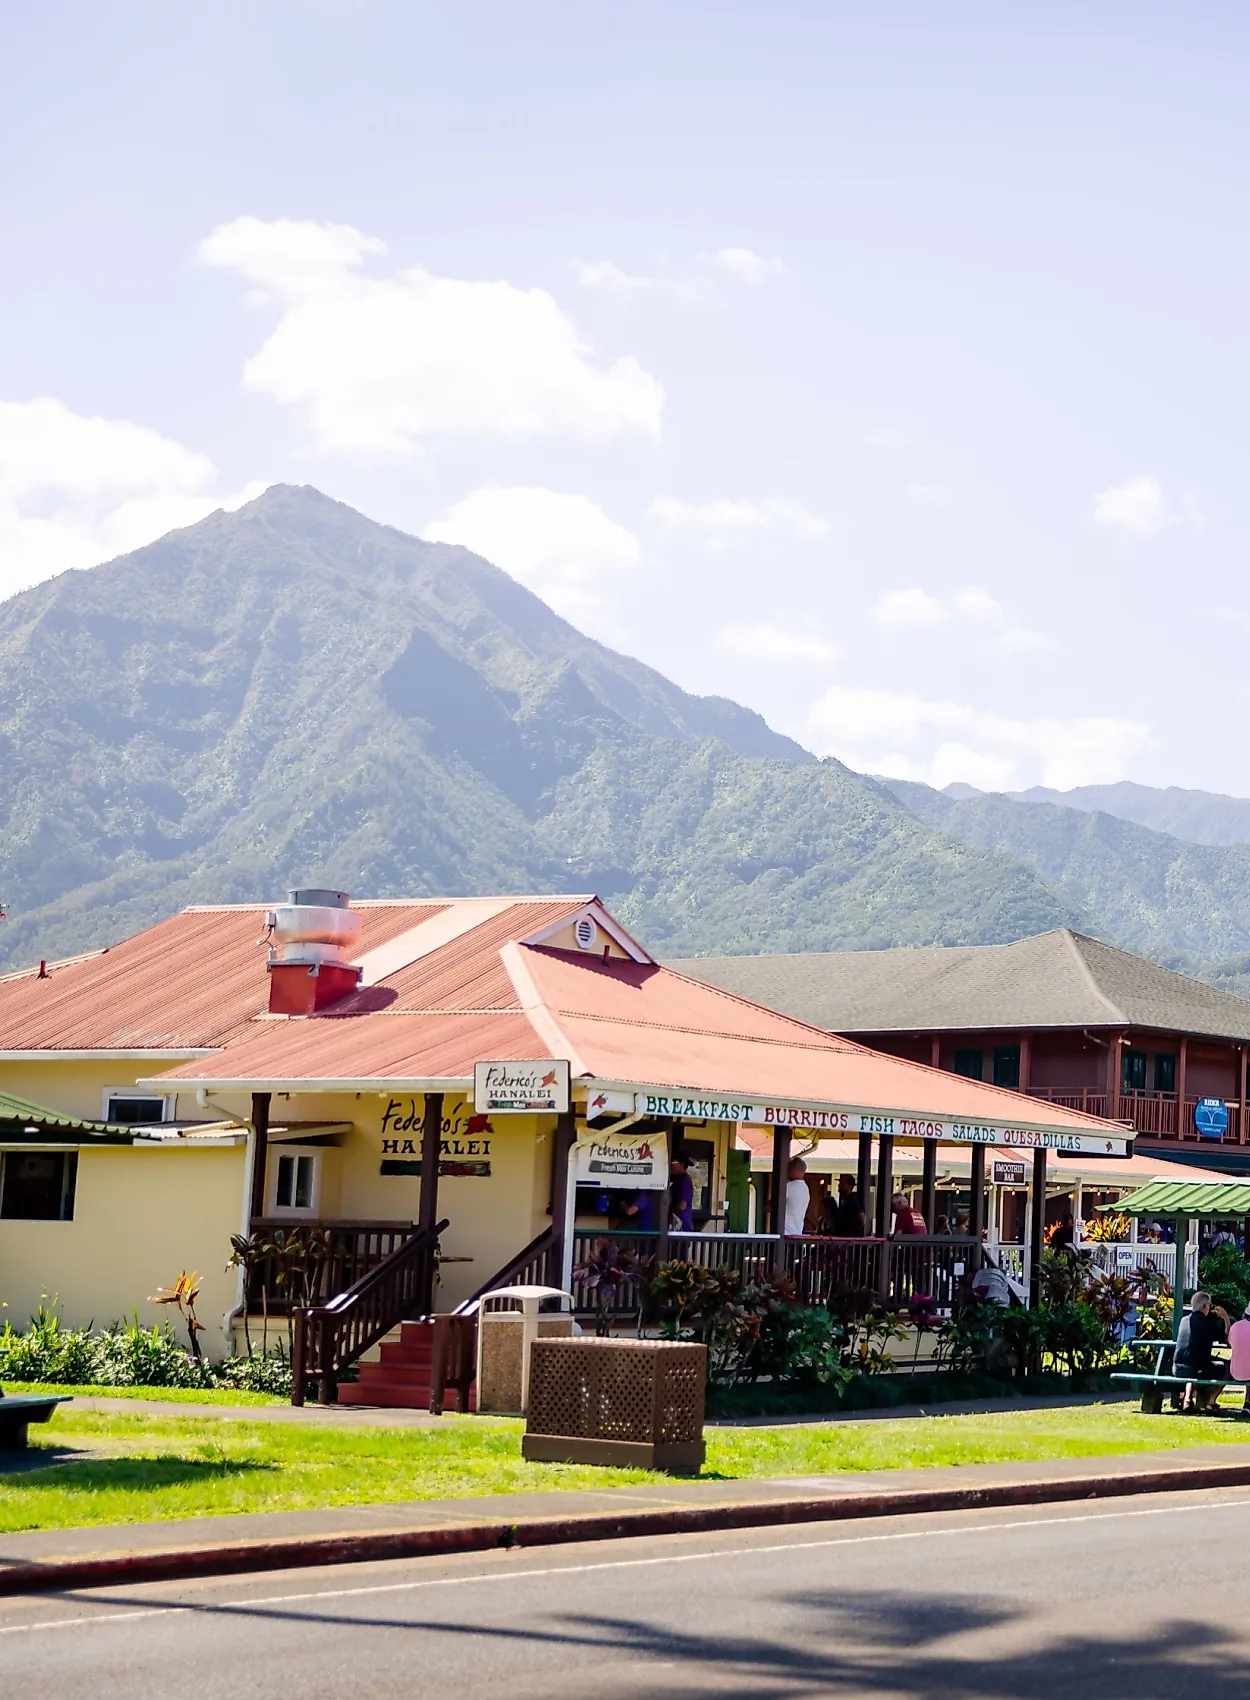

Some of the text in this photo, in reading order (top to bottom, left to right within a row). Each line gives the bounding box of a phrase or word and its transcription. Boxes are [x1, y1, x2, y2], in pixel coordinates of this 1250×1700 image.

[486, 1067, 537, 1088] Federico's
[489, 1090, 551, 1098] HANALEI
[382, 1099, 463, 1134] Fedeo's
[646, 1096, 1081, 1150] BREAKFAST BURRITOS FISH TACOS SALADS QUESADILLAS
[382, 1140, 491, 1155] HAALEI
[996, 1164, 1023, 1173] SMOOTHIE
[1004, 1173, 1015, 1181] BAR
[1118, 1251, 1131, 1260] OPEN
